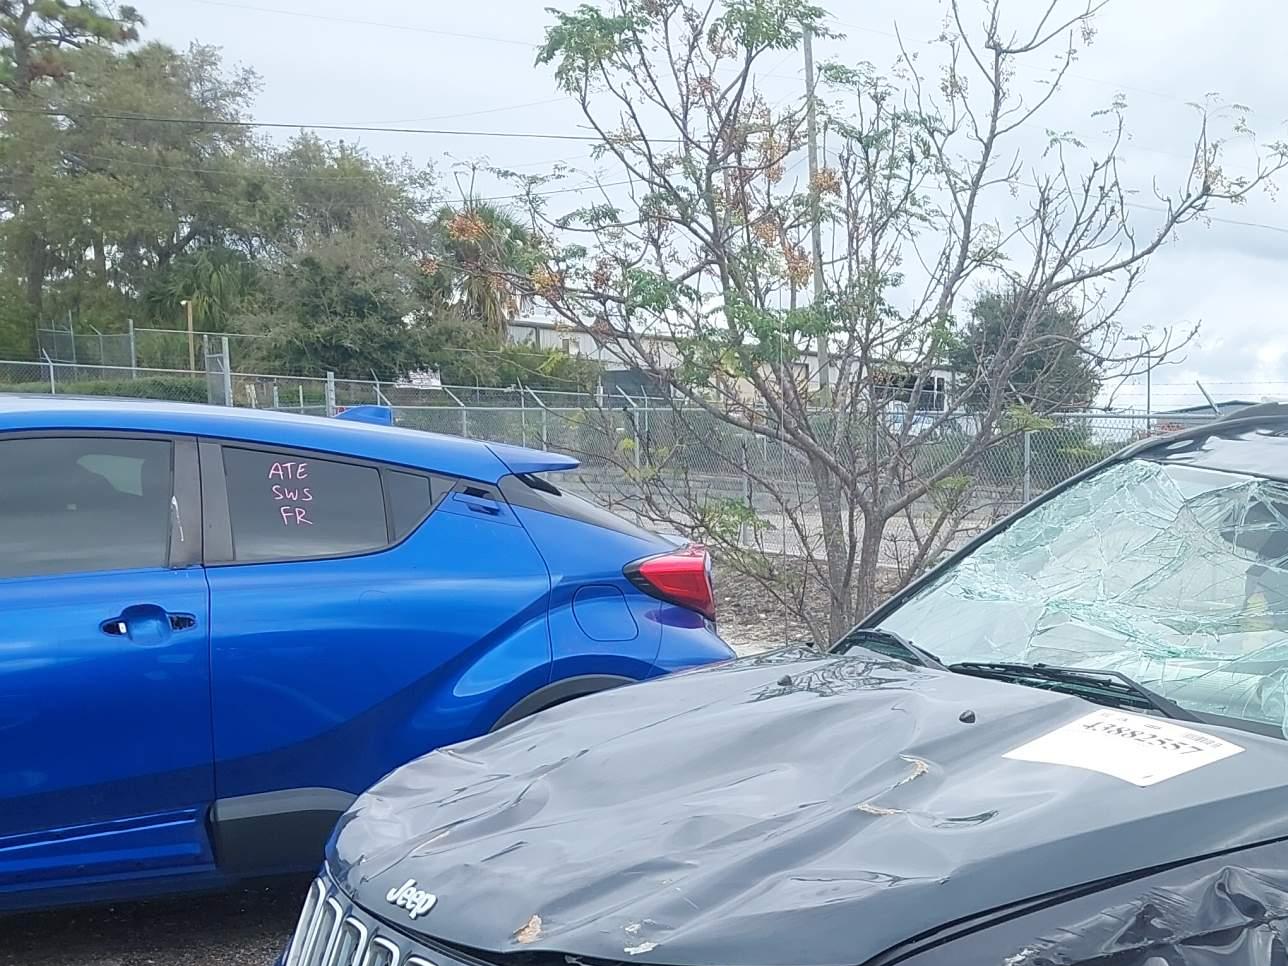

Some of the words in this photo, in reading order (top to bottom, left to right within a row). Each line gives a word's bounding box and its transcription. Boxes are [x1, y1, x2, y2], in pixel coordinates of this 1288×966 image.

[268, 462, 308, 480] ATE
[280, 506, 313, 525] FR
[386, 878, 437, 920] Jeep
